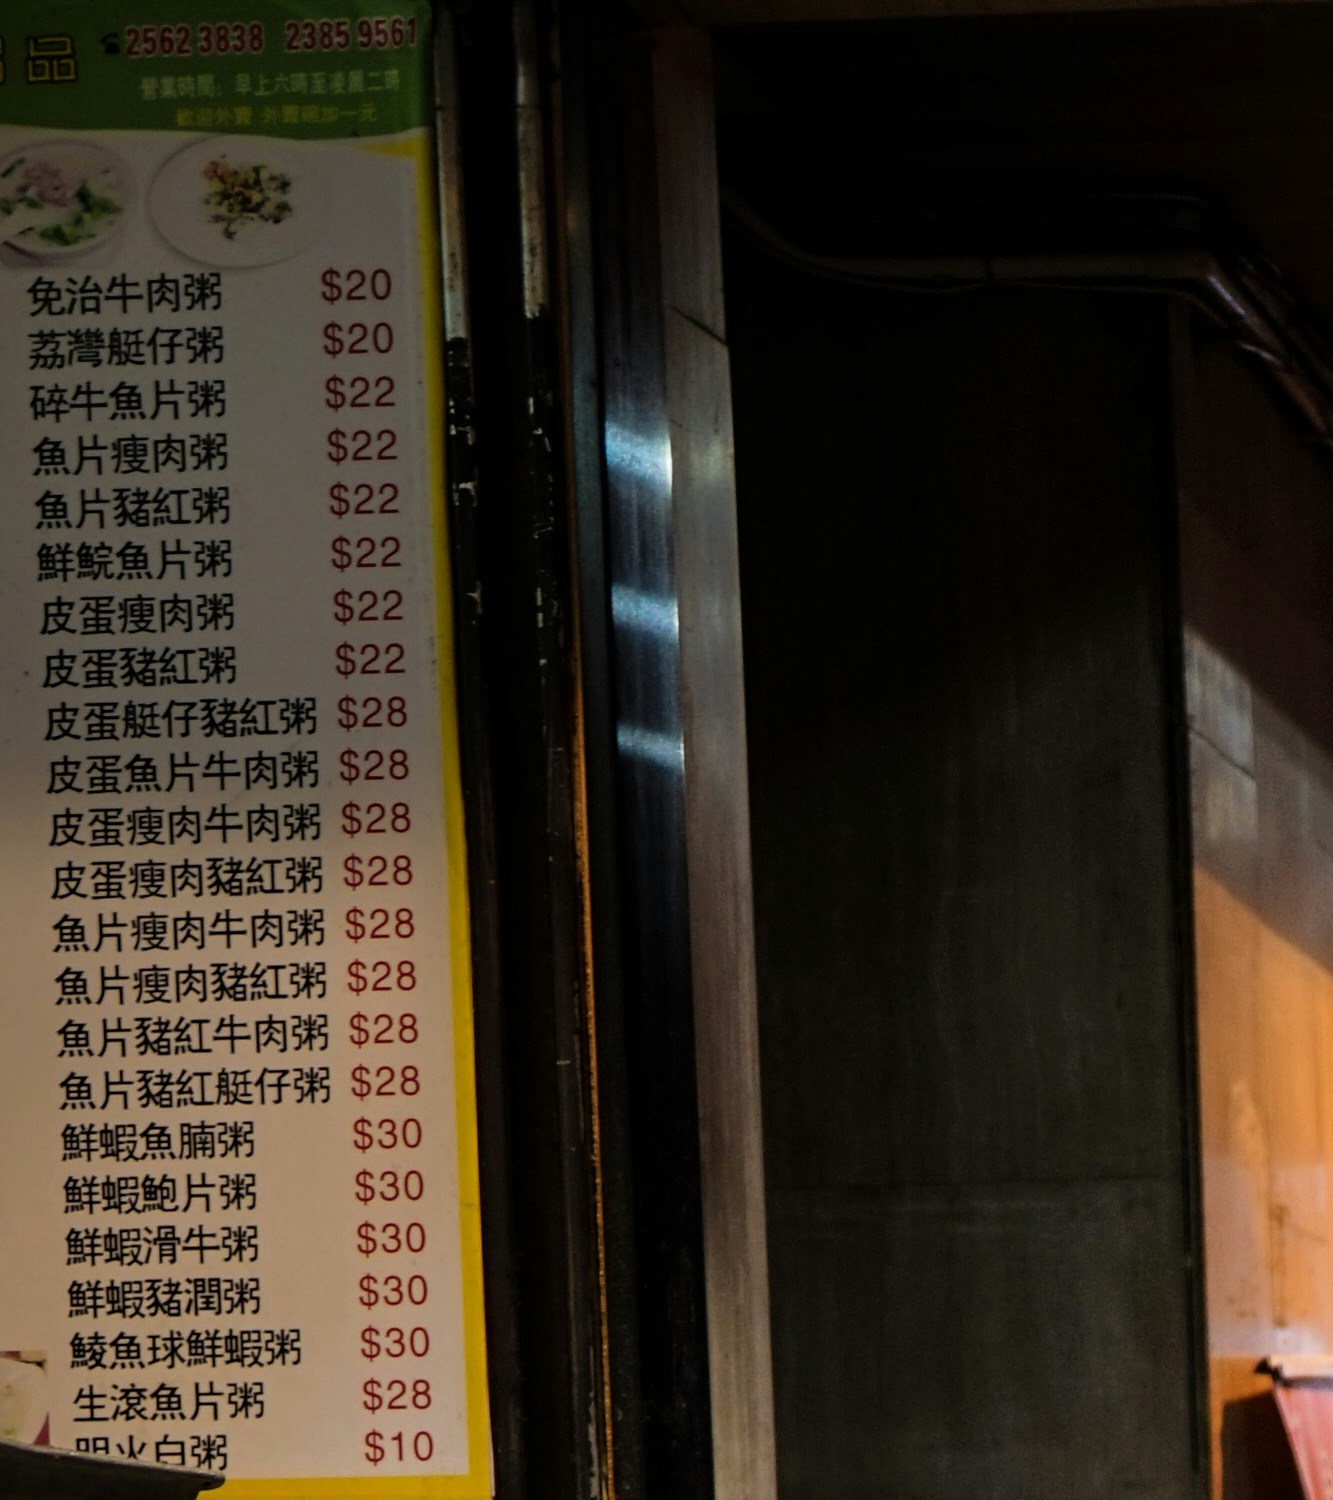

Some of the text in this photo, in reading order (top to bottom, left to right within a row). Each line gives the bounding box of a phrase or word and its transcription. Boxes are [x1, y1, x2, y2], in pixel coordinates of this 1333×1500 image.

[0, 34, 77, 83] 品
[124, 16, 418, 57] 2562 3838 2385 9561
[27, 268, 391, 317] 免治牛肉粥 $20
[28, 321, 393, 370] 荔灣艇仔粥 $20
[29, 375, 395, 423] 碎牛魚片粥 $22
[32, 428, 397, 476] 魚片瘦肉粥 $22
[34, 482, 399, 529] 魚片豬紅粥 $22
[37, 536, 401, 582] 鮮鯇魚片粥 $22
[40, 588, 403, 635] 皮蛋瘦肉粥 $22
[42, 642, 405, 688] 皮蛋豬紅粥 $22
[44, 695, 407, 741] 皮蛋艇仔豬紅粥 $28
[47, 748, 409, 794] 皮蛋魚片牛肉粥 $28
[49, 801, 410, 847] 皮蛋瘦肉牛肉粥 $28
[51, 853, 413, 900] 皮蛋瘦肉豬紅粥 $28
[52, 906, 414, 953] 魚片瘦肉牛肉粥 $28
[54, 959, 416, 1005] 魚片瘦肉豬紅粥 $28
[56, 1012, 418, 1057] 魚片豬紅牛肉粥 $28
[59, 1064, 420, 1110] 魚片豬紅艇仔粥 $28
[61, 1117, 422, 1162] 鮮蝦魚腩粥 $30
[63, 1169, 424, 1215] 鮮蝦鮑片粥 $30
[65, 1221, 425, 1266] 鮮蝦滑牛粥 $30
[67, 1274, 427, 1319] 鮮蝦豬潤粥 $30
[69, 1325, 429, 1370] 鯪魚球鮮蝦粥 $30
[73, 1378, 431, 1422] 生滾魚片粥 $28
[365, 1429, 433, 1466] $10
